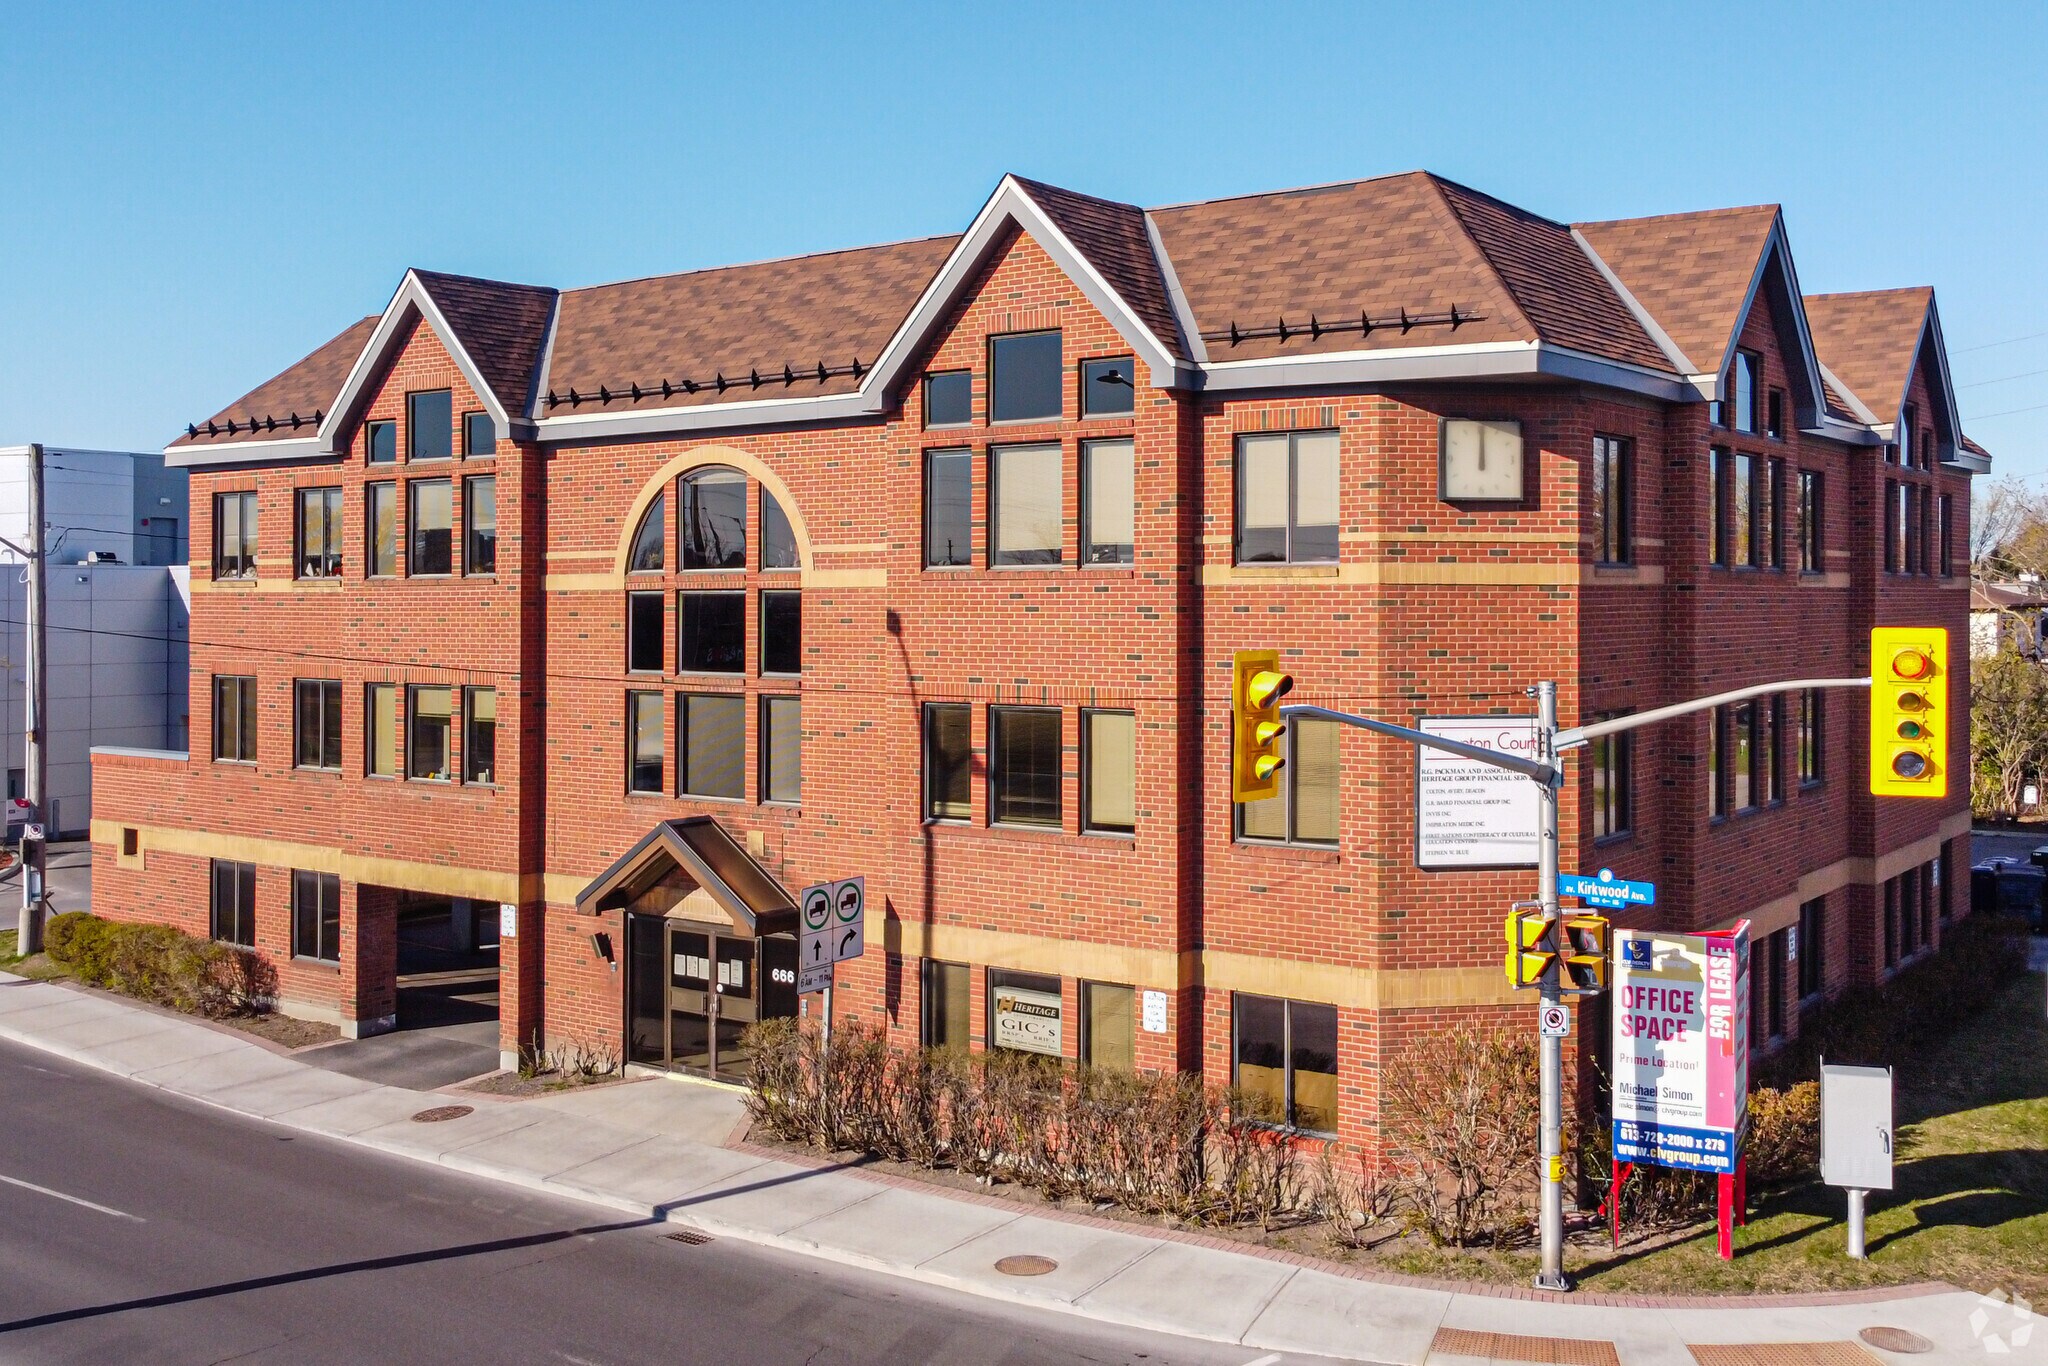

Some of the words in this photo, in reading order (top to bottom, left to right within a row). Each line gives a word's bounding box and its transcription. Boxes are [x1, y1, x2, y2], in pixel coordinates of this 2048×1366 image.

[1498, 732, 1537, 750] Court
[1565, 885, 1575, 893] av.
[1578, 881, 1629, 899] Kirkwood
[1631, 891, 1646, 901] Ave.
[772, 968, 795, 984] 666
[1709, 946, 1732, 1000] LEASE
[1014, 1002, 1057, 1017] HERITAGE
[1621, 985, 1694, 1015] OFFICE
[1621, 1014, 1688, 1042] SPACE
[1619, 1053, 1649, 1066] Prime
[1619, 1082, 1658, 1098] Michael
[1662, 1086, 1693, 1101] Simon
[1704, 1137, 1726, 1152] 279
[1617, 1143, 1729, 1168] www.clvgroup.com
